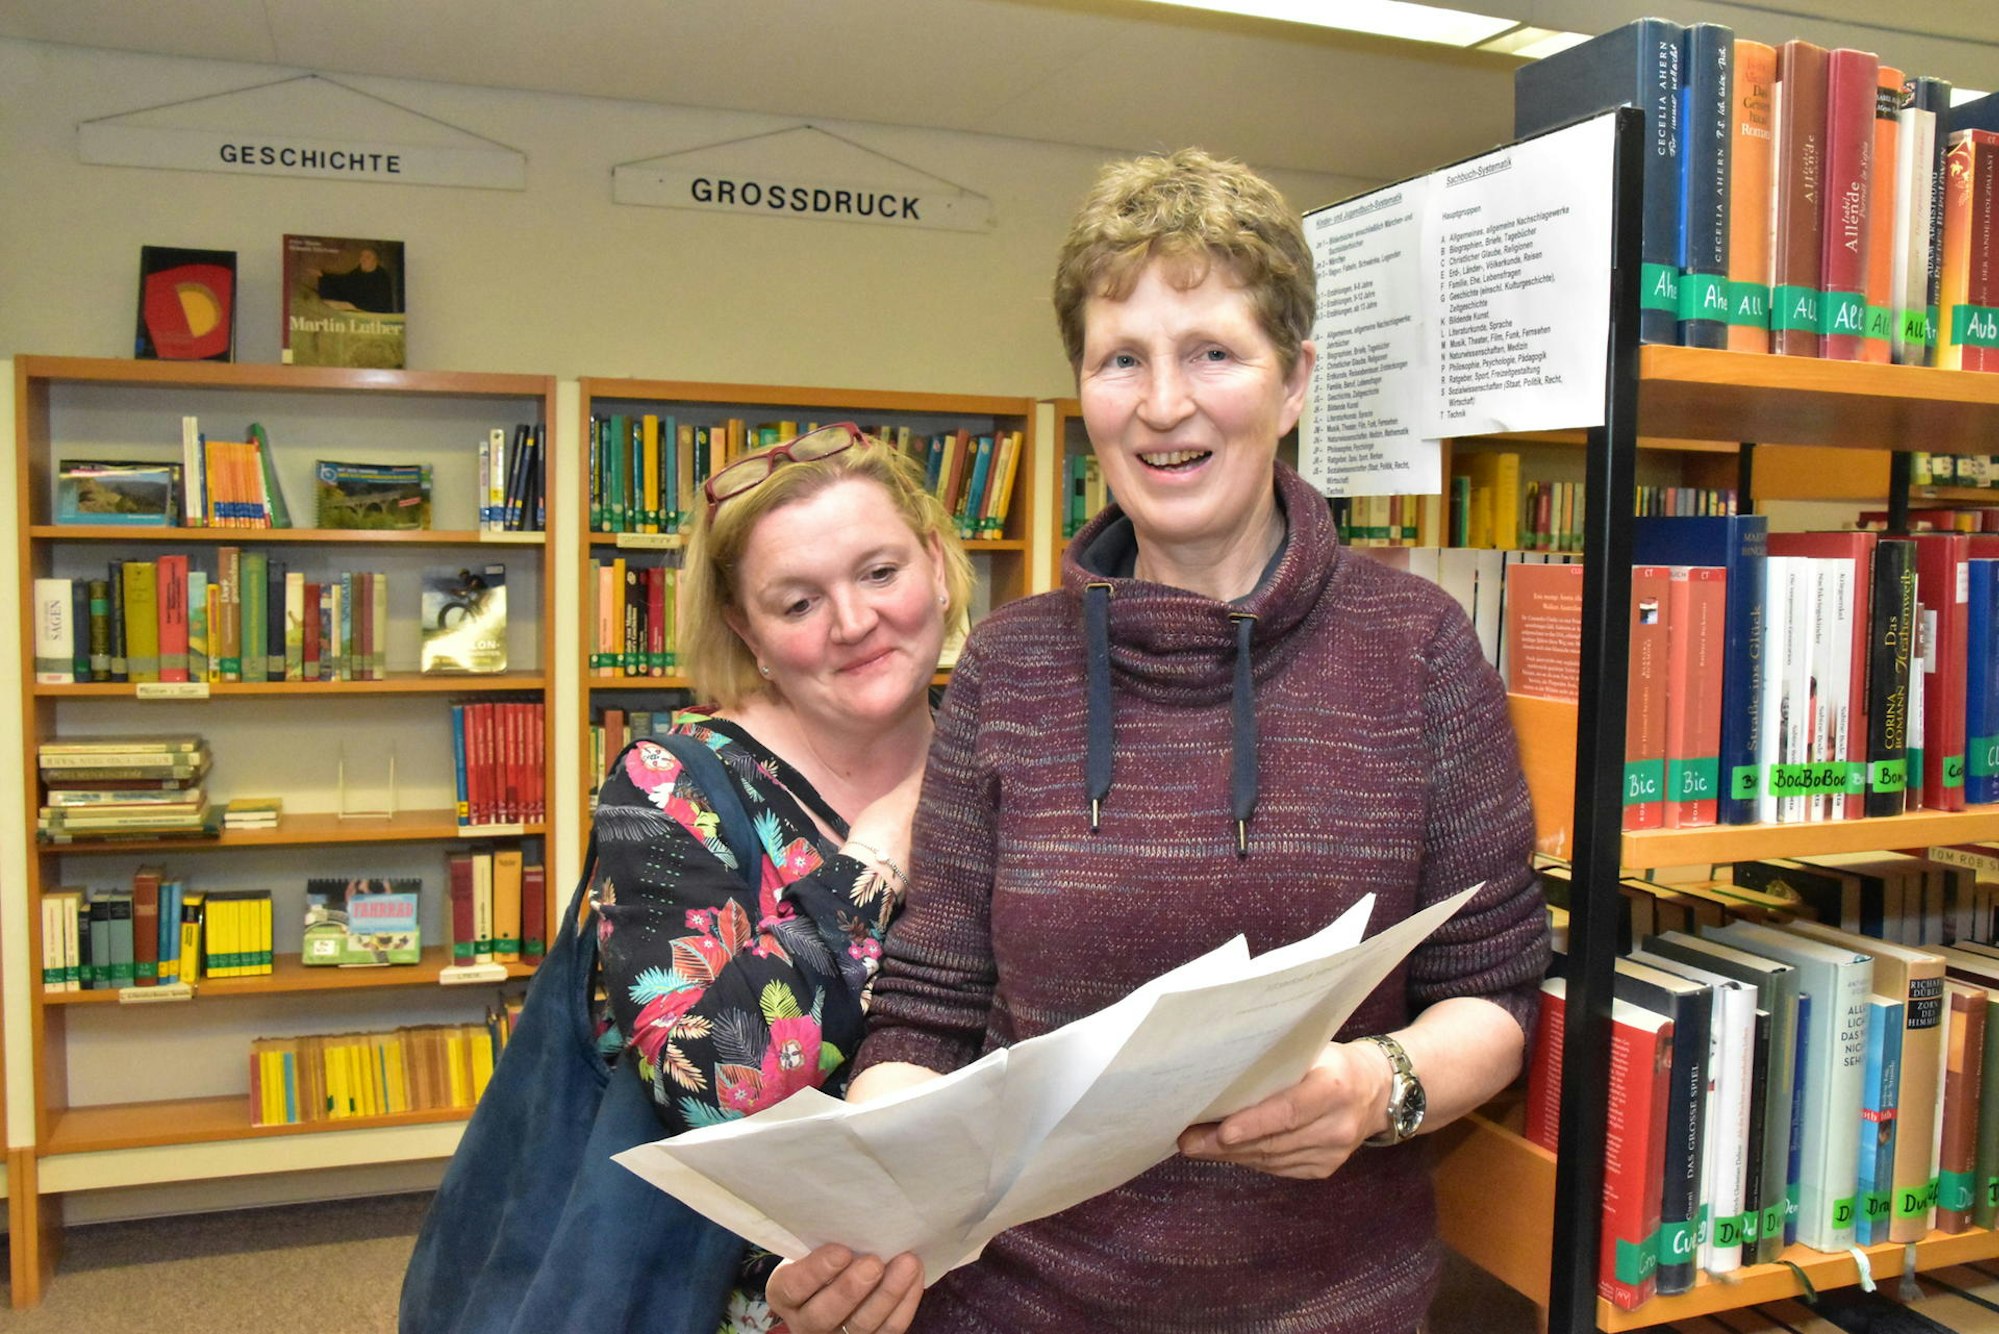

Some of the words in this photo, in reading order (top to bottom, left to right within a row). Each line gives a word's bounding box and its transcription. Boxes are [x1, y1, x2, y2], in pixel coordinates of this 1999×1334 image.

[1658, 40, 1667, 89] AHERN
[1657, 96, 1667, 156] CECELIA
[220, 144, 401, 174] GESCHICHTE
[1446, 157, 1512, 186] Sachbuch-Systematik
[1716, 148, 1725, 195] AHERN
[1804, 134, 1815, 203] Allende
[691, 178, 920, 220] GROSSDRUCK
[1442, 205, 1481, 221] Hauptgruppen
[1486, 221, 1515, 235] allgemeine
[1516, 206, 1569, 226] Nachschlagewerke
[1845, 182, 1860, 253] Allende
[1504, 227, 1537, 242] Tagebücher
[1714, 205, 1723, 262] CECELIA
[1449, 252, 1479, 266] Christlicher
[1503, 241, 1533, 255] Religionen
[1523, 251, 1542, 262] Reisen
[1483, 268, 1521, 283] Lebensfragen
[1654, 271, 1677, 299] Ahe
[1449, 289, 1478, 301] Geschichte
[1449, 299, 1488, 314] Zeitgeschichte
[1704, 284, 1728, 311] Ahe
[1738, 296, 1763, 316] All
[289, 315, 345, 332] Martin
[350, 319, 403, 335] Luther
[1449, 314, 1472, 325] Bildende
[1473, 311, 1489, 321] Kunst
[1489, 320, 1512, 332] Sprache
[1905, 321, 1924, 338] All
[1967, 312, 1997, 339] Aub
[1522, 326, 1551, 338] Fernsehen
[1507, 342, 1528, 352] Medizin
[1518, 351, 1547, 366] Pädagogik
[1491, 365, 1540, 380] Freizeitgestaltung
[1447, 409, 1466, 419] Technik
[51, 600, 62, 641] SAGEN
[1749, 604, 1761, 660] Glück
[1885, 616, 1898, 646] Das
[1749, 664, 1760, 689] ins
[1747, 694, 1759, 752] Straße
[1884, 694, 1897, 750] CORINA
[1894, 685, 1905, 749] BOMANN
[1629, 774, 1655, 797] Bic
[1683, 771, 1708, 794] Bic
[1931, 848, 1956, 862] TOM
[1961, 853, 1984, 868] ROB
[353, 902, 413, 918] FAHRRAD
[1841, 1031, 1860, 1042] DAS
[1690, 1064, 1699, 1098] SPIEL
[1688, 1101, 1698, 1151] GROSSE
[1686, 1154, 1696, 1179] DAS
